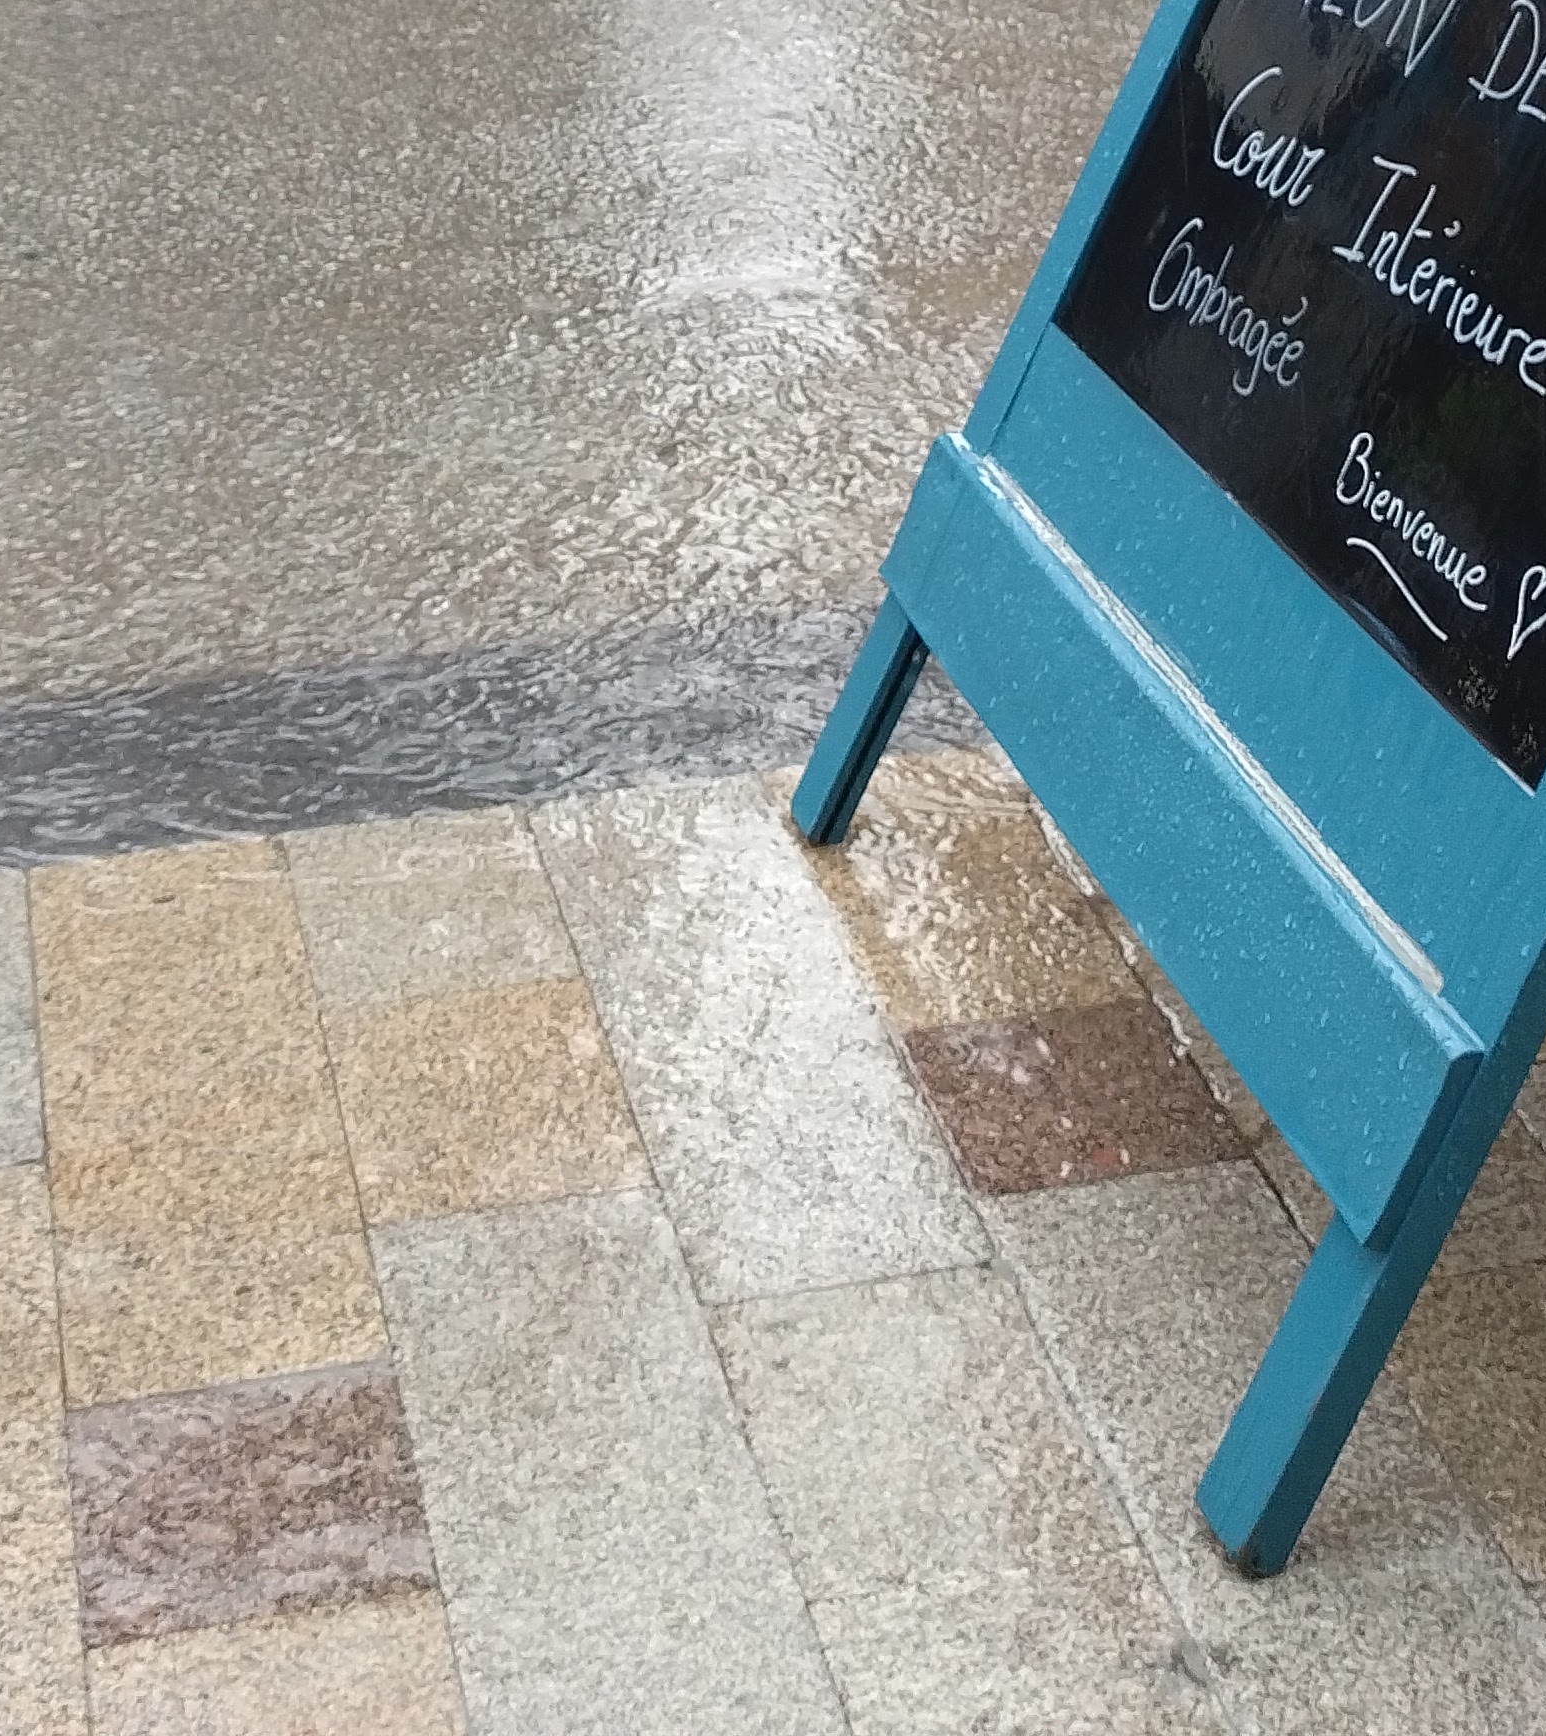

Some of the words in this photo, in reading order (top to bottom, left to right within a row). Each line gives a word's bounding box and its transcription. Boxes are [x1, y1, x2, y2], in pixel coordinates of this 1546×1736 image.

[1212, 66, 1326, 207] Cour
[1147, 216, 1308, 398] Ombragée
[1335, 431, 1490, 612] Bienvenue
